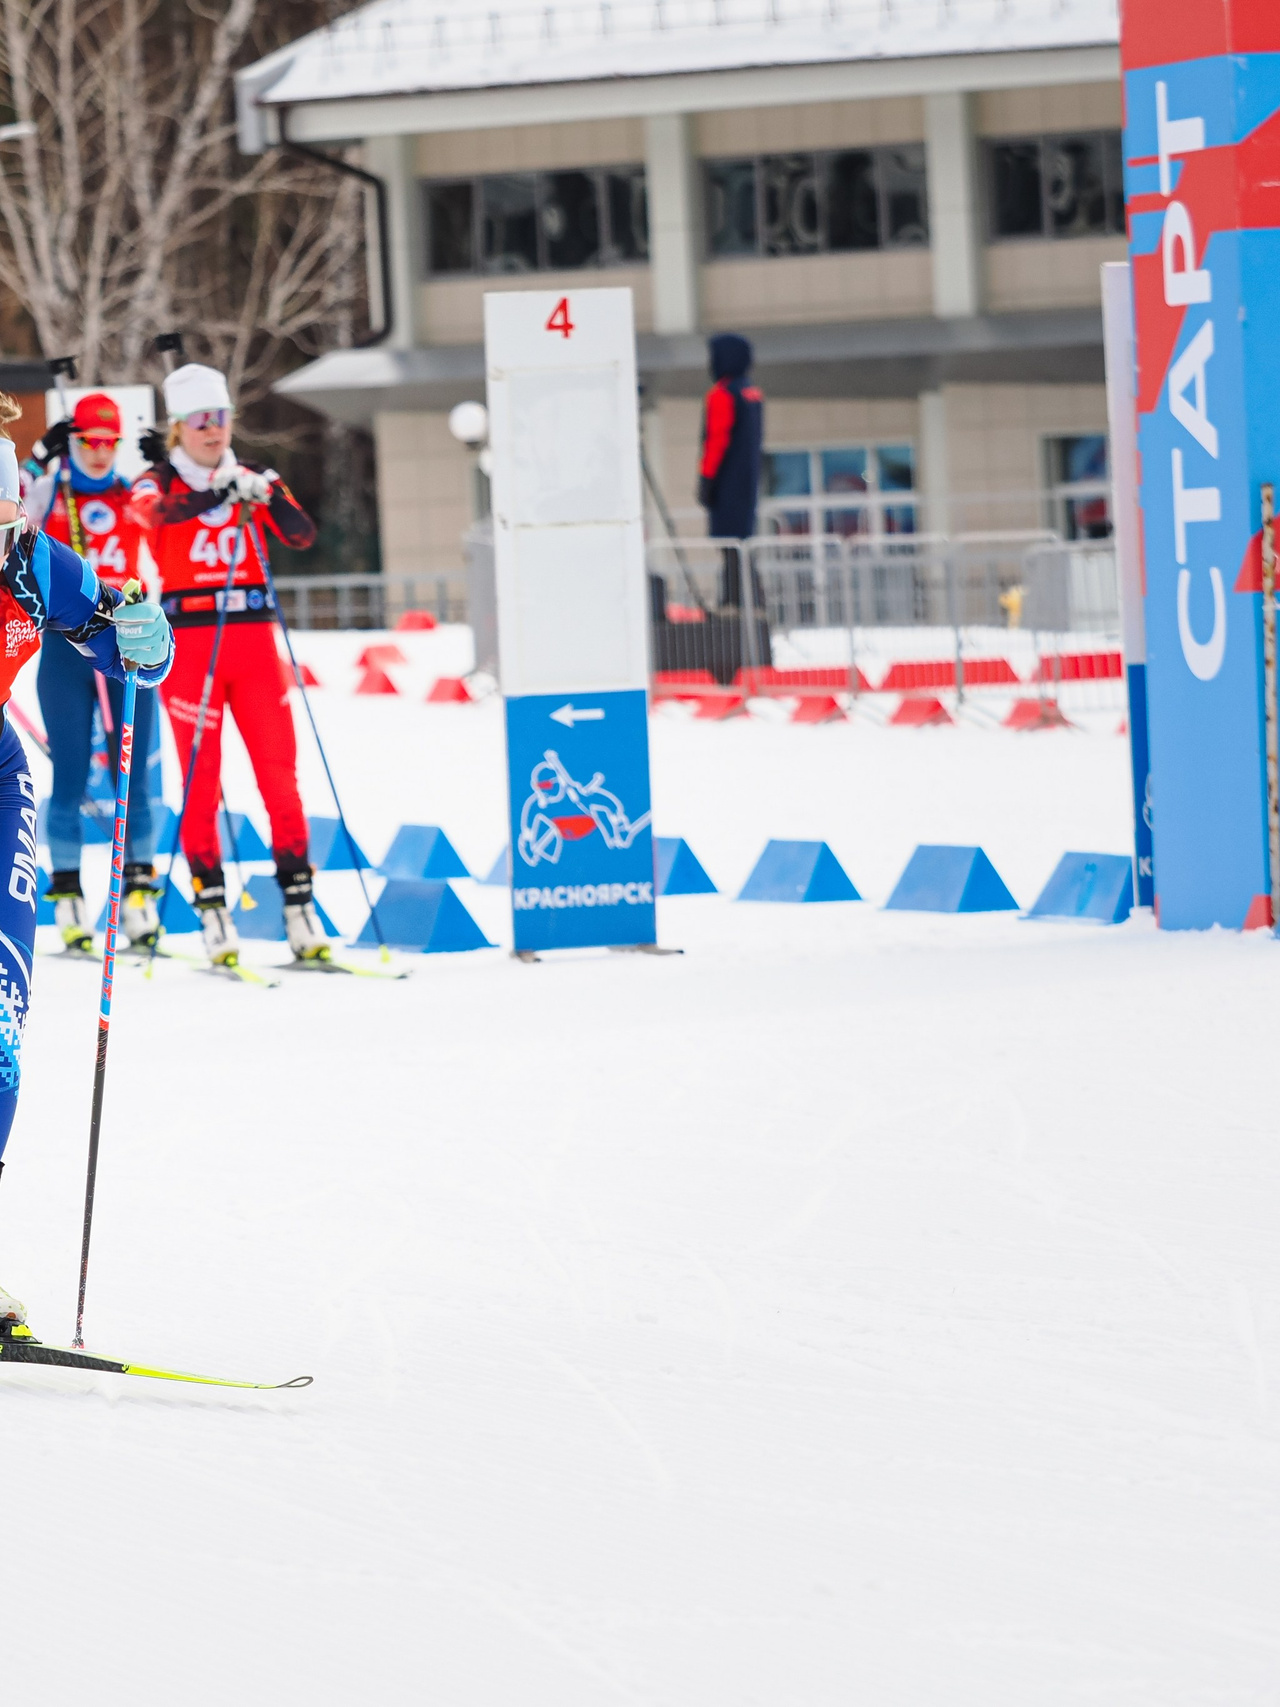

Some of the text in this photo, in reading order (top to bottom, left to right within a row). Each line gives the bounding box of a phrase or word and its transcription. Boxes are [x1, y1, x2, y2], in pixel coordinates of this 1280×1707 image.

[546, 297, 574, 338] 4
[1155, 80, 1227, 682] СТАРТ
[189, 526, 246, 567] 40
[513, 882, 653, 911] КРАСНОЯРСК
